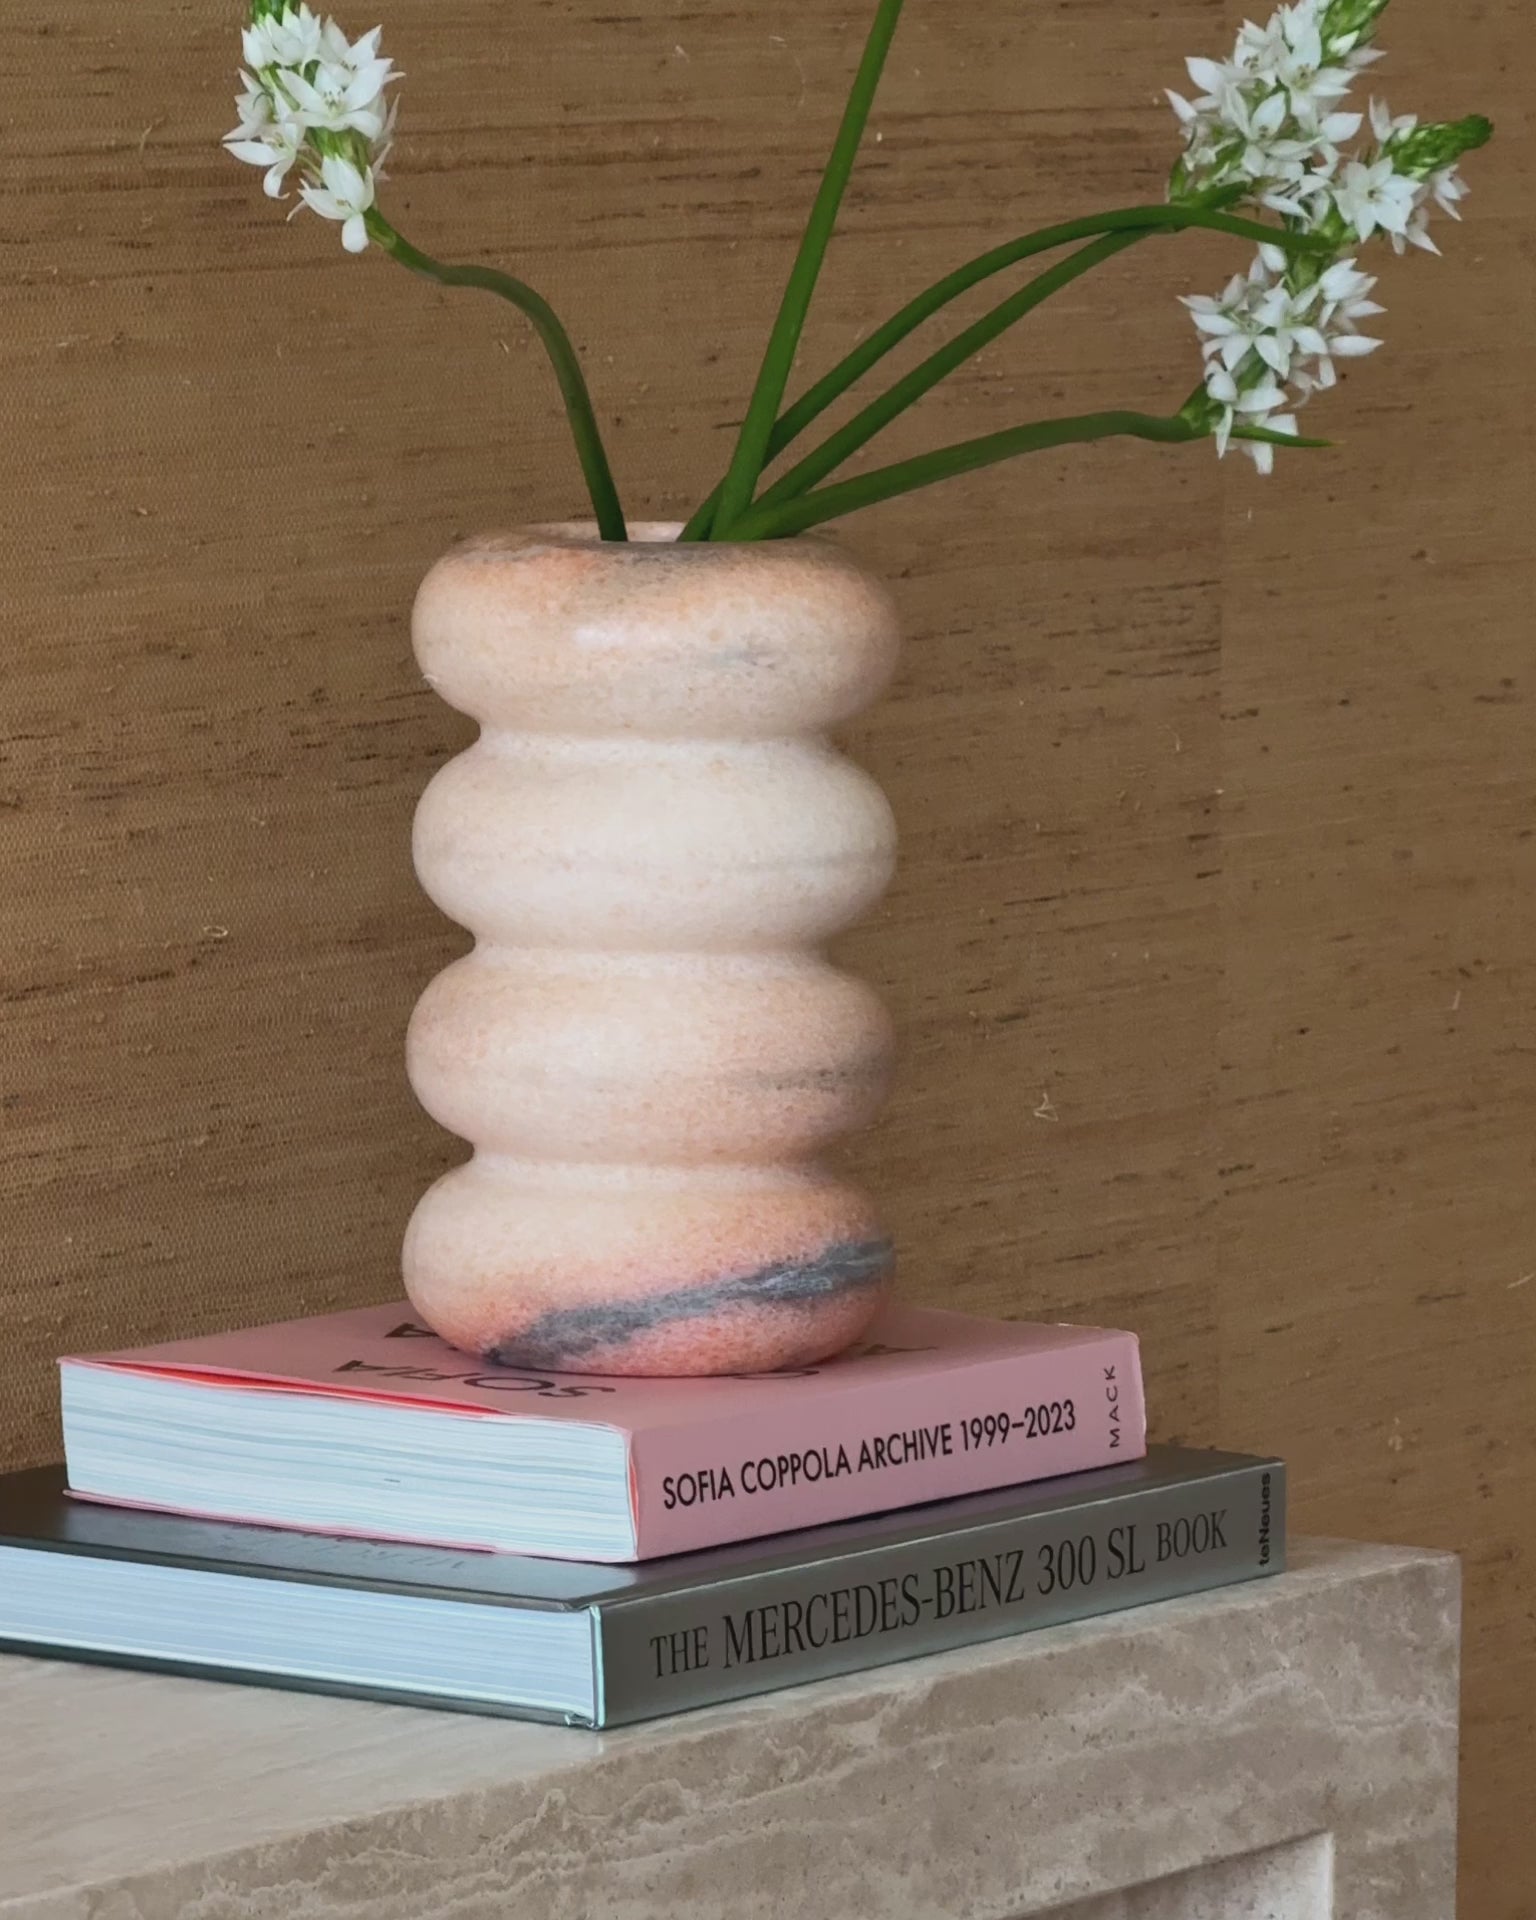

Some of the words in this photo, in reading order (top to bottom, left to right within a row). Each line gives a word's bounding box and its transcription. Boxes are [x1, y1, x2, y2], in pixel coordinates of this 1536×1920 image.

[1103, 1364, 1120, 1448] MACK
[662, 1466, 735, 1510] SOFIA
[740, 1443, 851, 1494] COPPOLA
[857, 1422, 953, 1473] ARCHIVE
[1257, 1472, 1272, 1566] teNeues
[650, 1625, 709, 1677] THE
[723, 1549, 1025, 1669] MERCEDES-BENZ
[1037, 1535, 1096, 1596] 300
[1106, 1524, 1146, 1580] SL
[1155, 1509, 1228, 1562] BOOK
